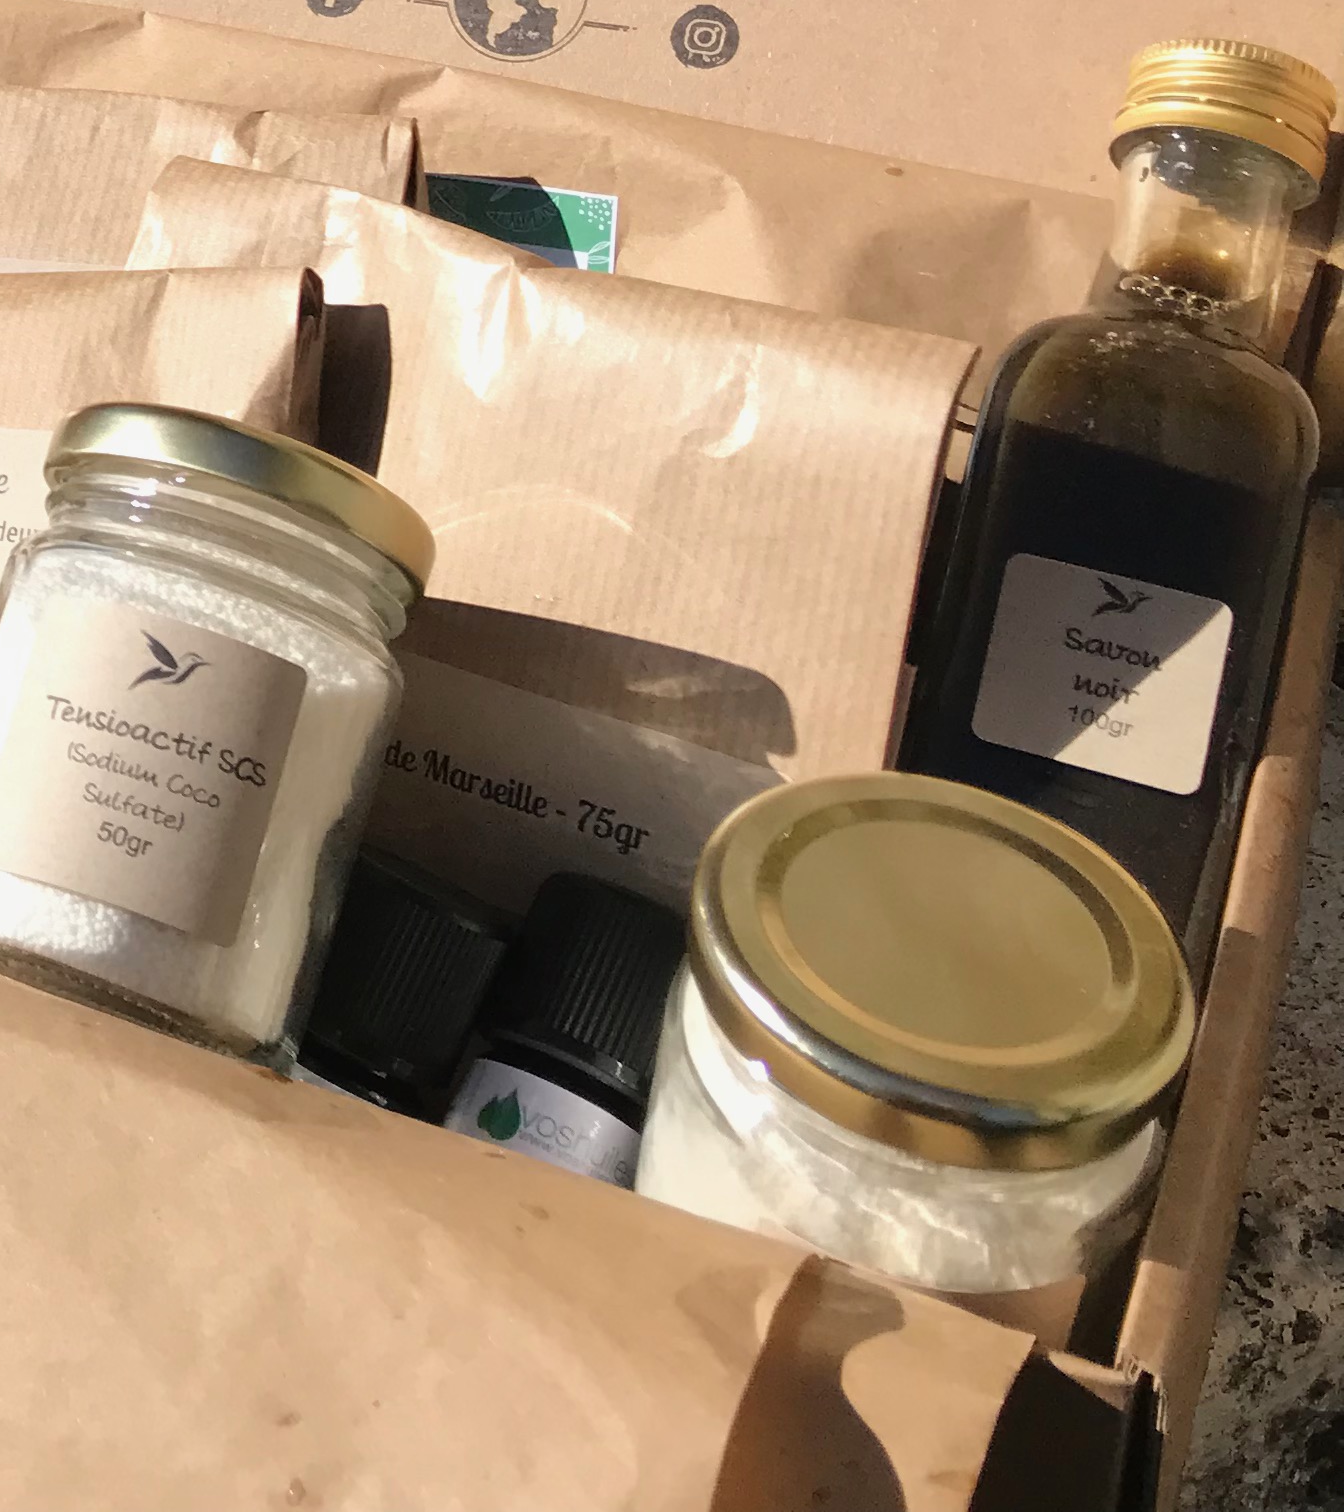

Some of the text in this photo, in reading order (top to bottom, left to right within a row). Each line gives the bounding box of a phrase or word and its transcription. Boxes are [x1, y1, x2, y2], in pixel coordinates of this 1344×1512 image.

[1064, 627, 1162, 671] Savon
[1072, 674, 1140, 705] noir
[1067, 704, 1134, 738] 100gr
[47, 695, 267, 787] Tensioactif SCS
[166, 774, 221, 808] Coco
[383, 740, 418, 772] de
[422, 749, 549, 818] Marseille
[577, 799, 650, 855] 75gr
[96, 820, 154, 857] 50gr
